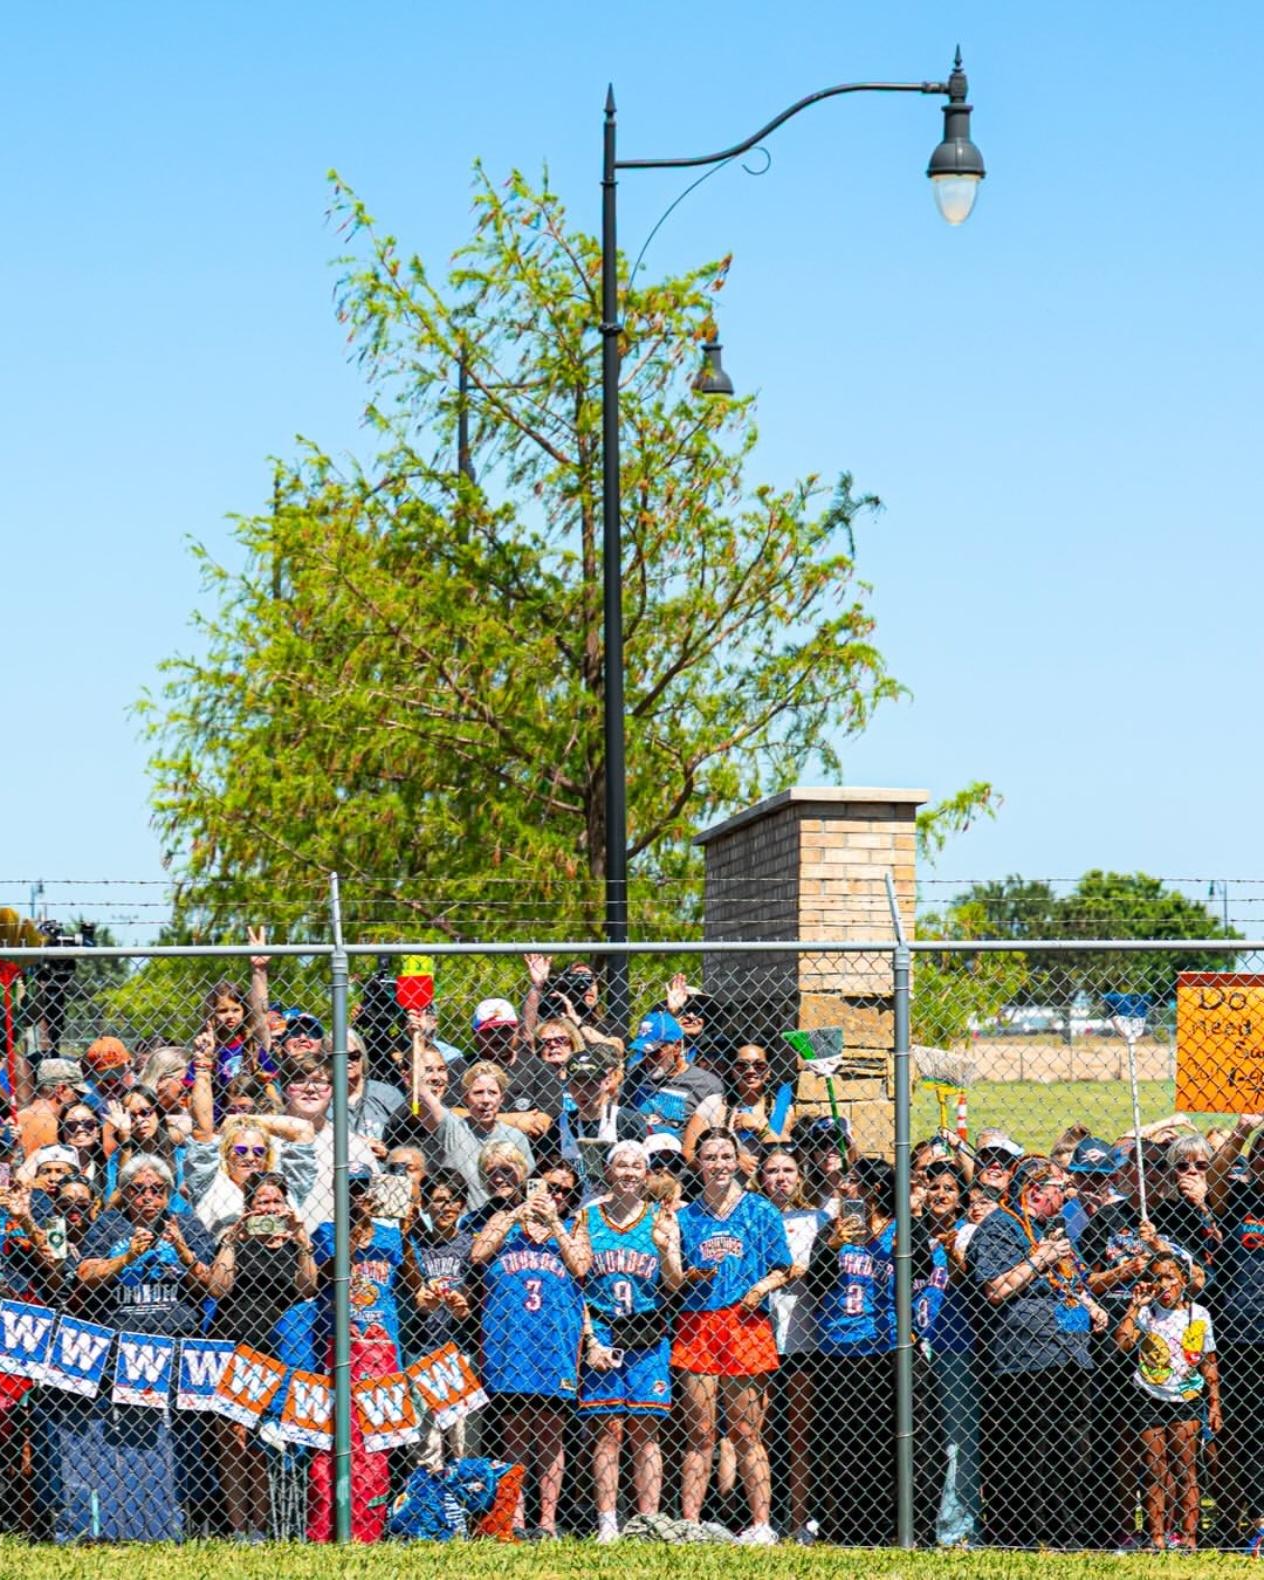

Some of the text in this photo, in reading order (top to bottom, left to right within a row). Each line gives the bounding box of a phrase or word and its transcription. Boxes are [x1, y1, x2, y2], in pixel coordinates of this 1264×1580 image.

[1199, 988, 1247, 1011] Do
[525, 1280, 542, 1311] 3
[614, 1281, 632, 1316] 9
[847, 1284, 863, 1315] 2
[0, 1310, 53, 1352] W
[60, 1326, 112, 1371] W
[118, 1343, 172, 1383] W
[182, 1350, 235, 1387] W
[230, 1354, 282, 1402] W
[293, 1380, 336, 1425] W
[356, 1383, 405, 1427] W
[413, 1353, 465, 1401] W
